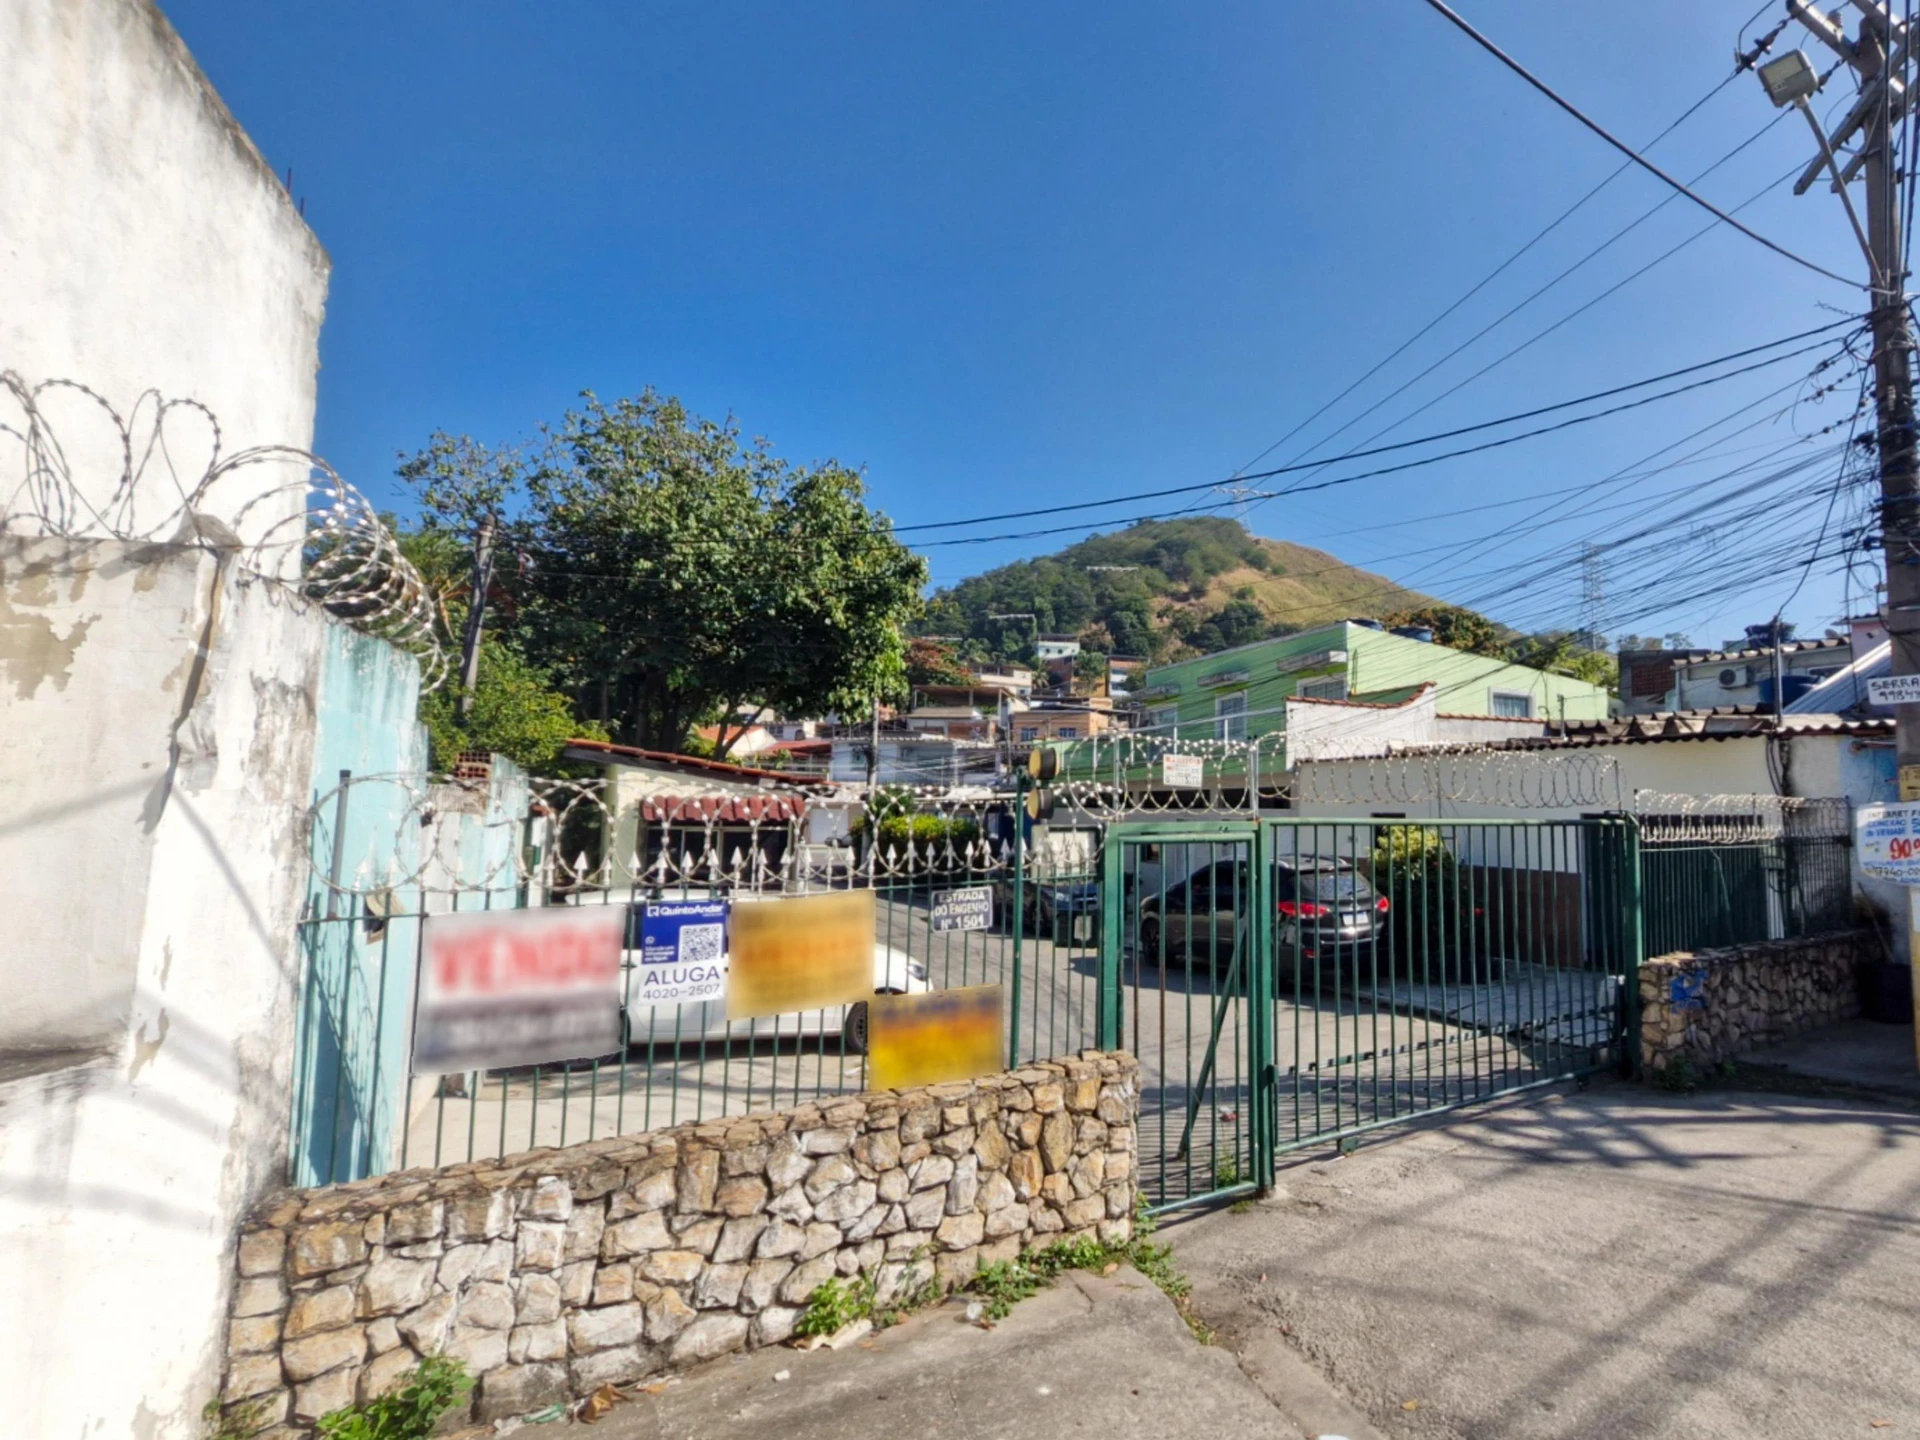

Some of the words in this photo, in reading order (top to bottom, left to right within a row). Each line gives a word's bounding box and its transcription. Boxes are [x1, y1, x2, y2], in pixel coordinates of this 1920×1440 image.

[938, 890, 985, 903] ESTRADA
[660, 904, 724, 917] QuintoAndar
[935, 905, 948, 916] DO
[949, 902, 989, 915] ENGENHO
[644, 965, 720, 986] ALUGA
[643, 984, 720, 999] 4020-2507
